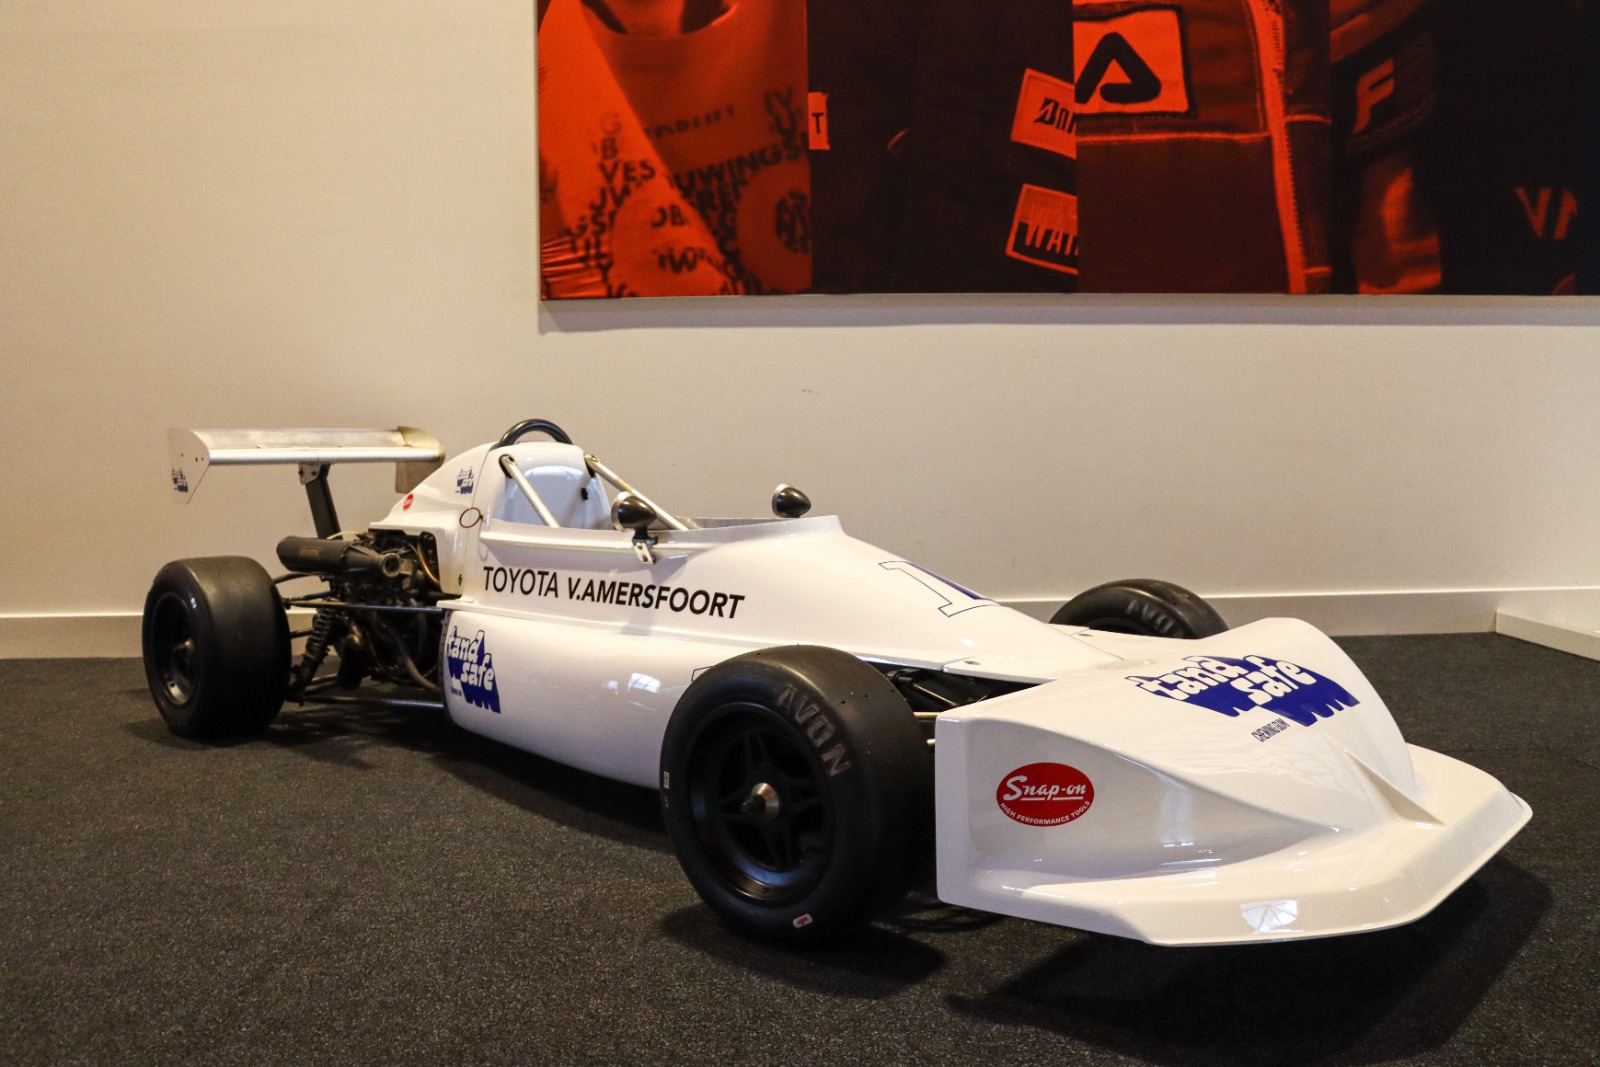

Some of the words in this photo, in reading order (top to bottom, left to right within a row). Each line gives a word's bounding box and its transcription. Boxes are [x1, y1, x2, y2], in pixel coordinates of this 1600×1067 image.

[483, 566, 560, 599] TOYOTA
[567, 576, 746, 620] V.AMERSFOORT
[1125, 599, 1183, 638] AVO
[776, 683, 853, 778] AVON
[1002, 774, 1087, 801] Snap-on
[1000, 802, 1016, 818] HIGH
[1016, 814, 1070, 825] PERFORMANCE
[1071, 800, 1091, 818] TOOLS
